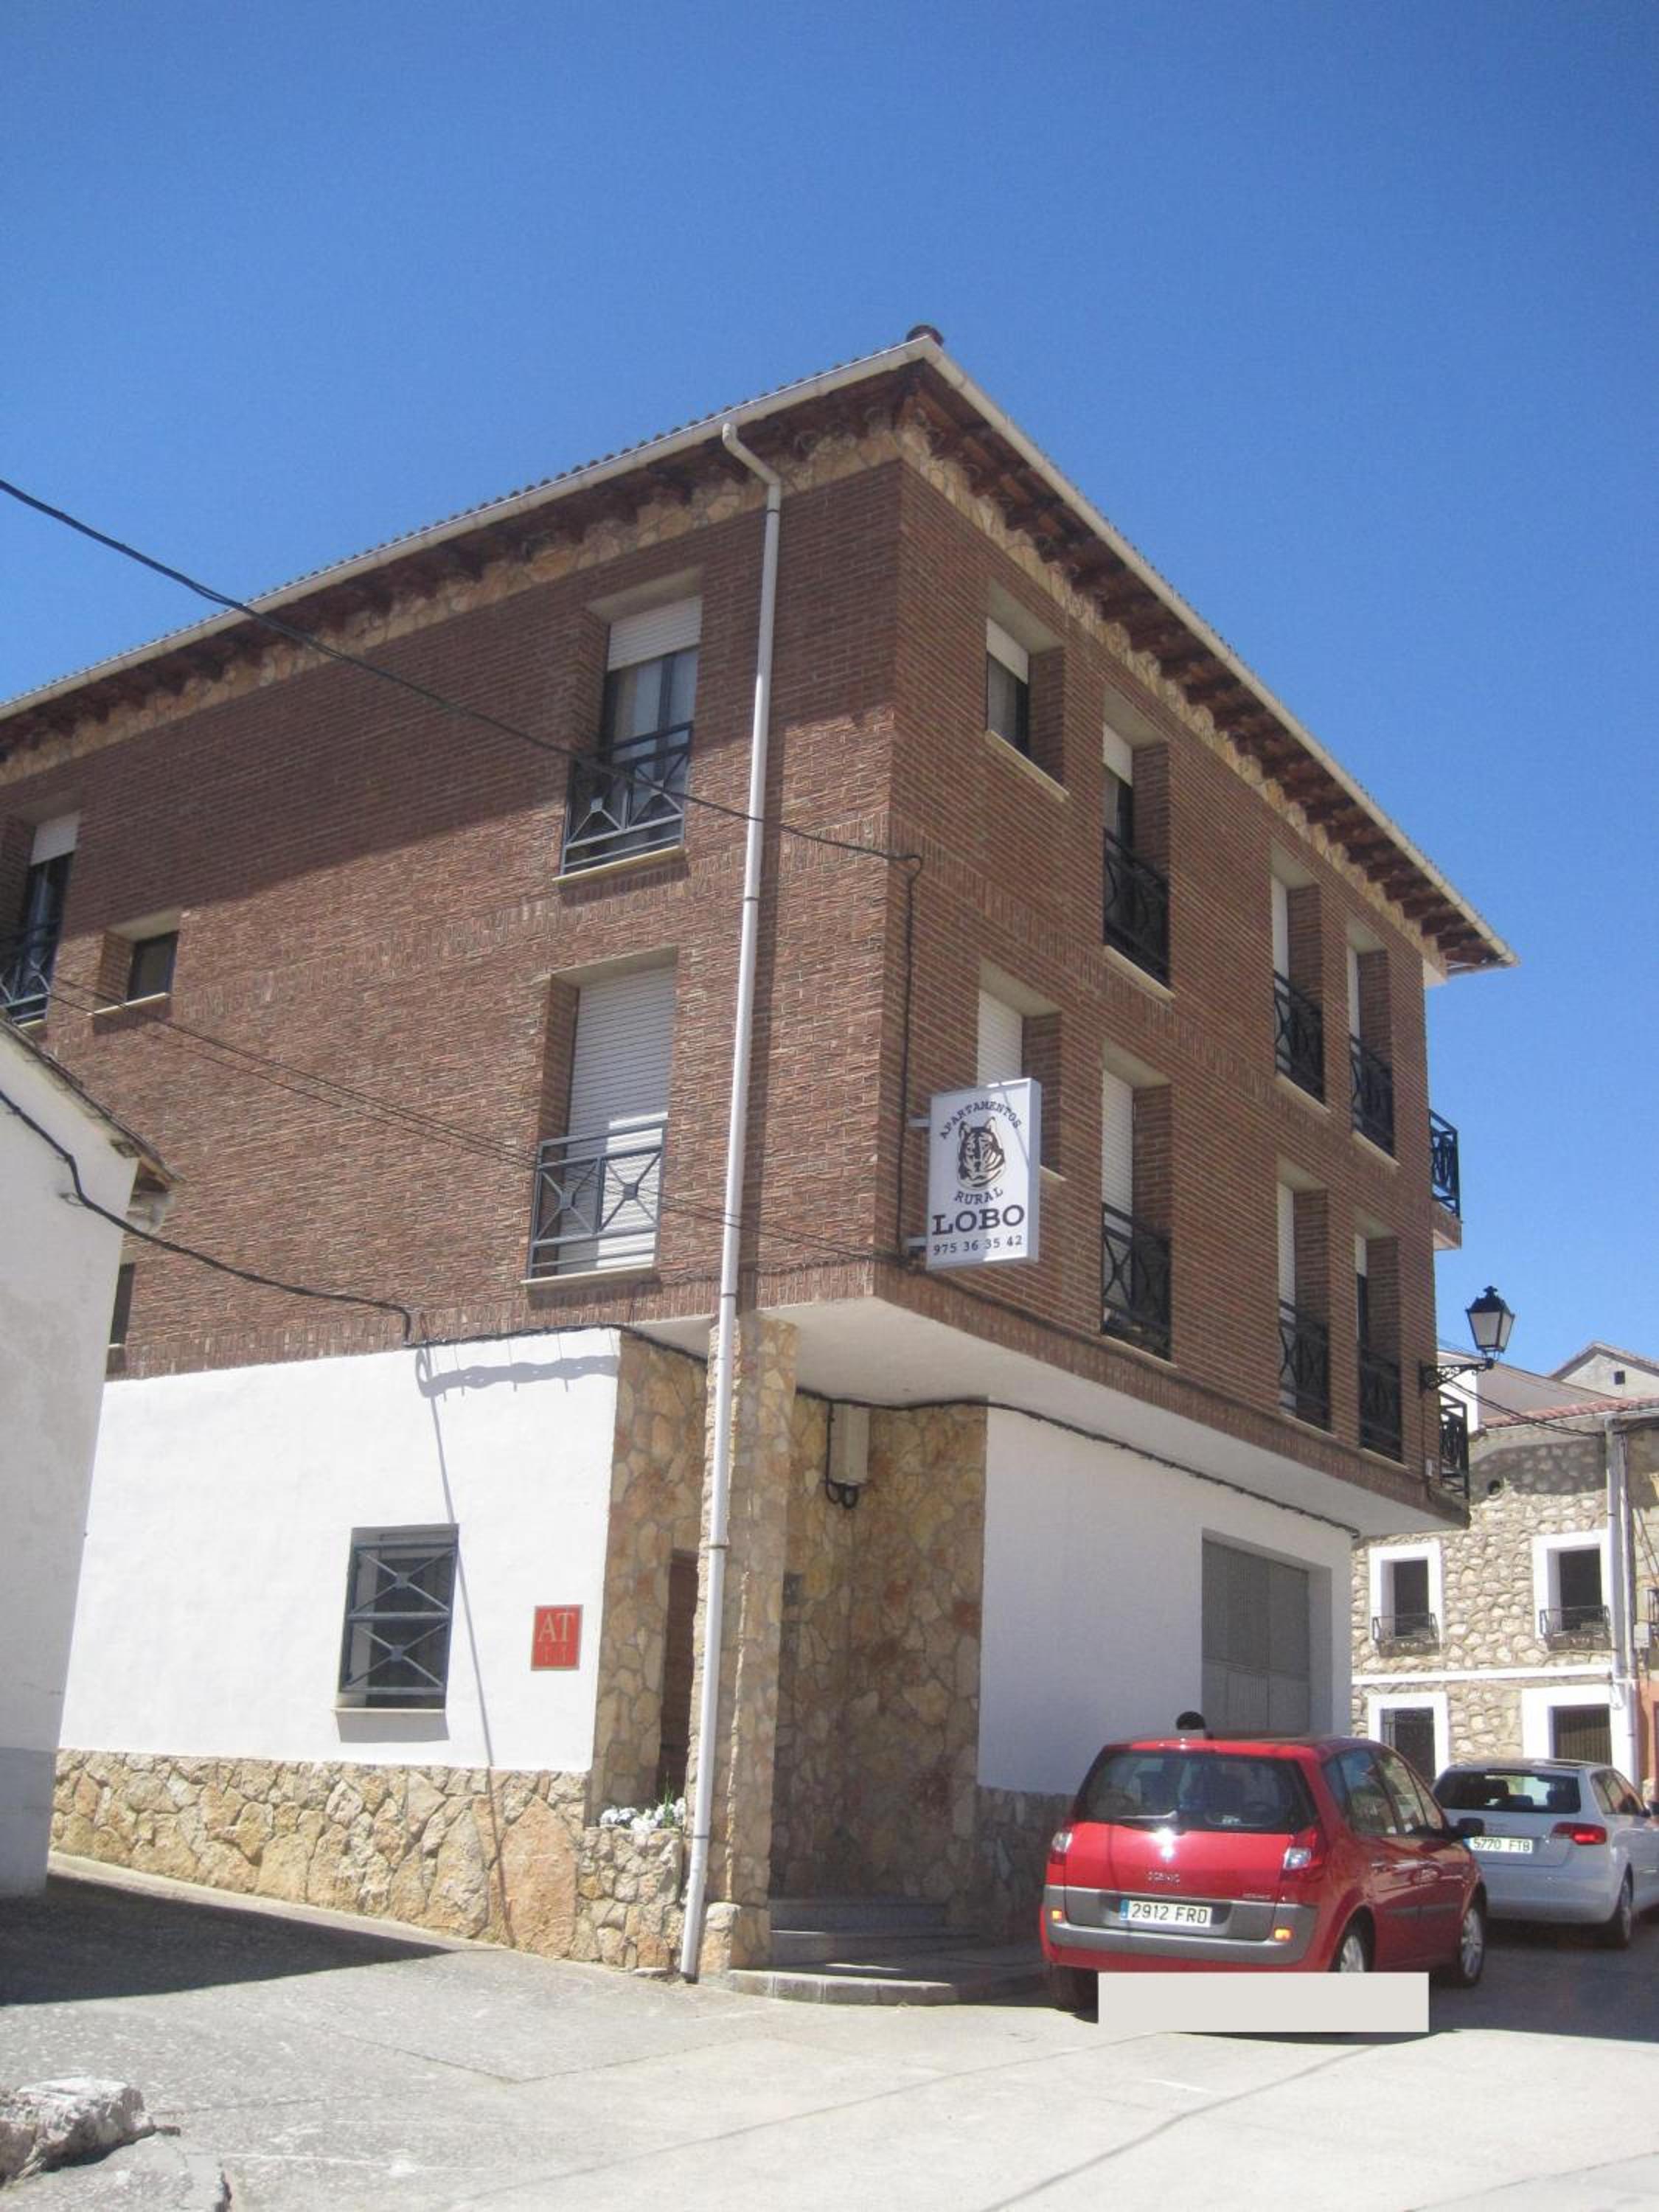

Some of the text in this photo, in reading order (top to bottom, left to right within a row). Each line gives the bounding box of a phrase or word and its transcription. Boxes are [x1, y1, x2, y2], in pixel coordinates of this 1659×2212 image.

[940, 1101, 1022, 1139] APARTAMENTOS
[954, 1188, 1004, 1204] RURAL
[932, 1204, 1025, 1236] LOBO
[933, 1235, 1023, 1255] 975 36 35 42
[536, 1612, 575, 1643] AT
[1473, 1837, 1502, 1850] 5770
[1132, 1903, 1208, 1924] 2912 FRD
